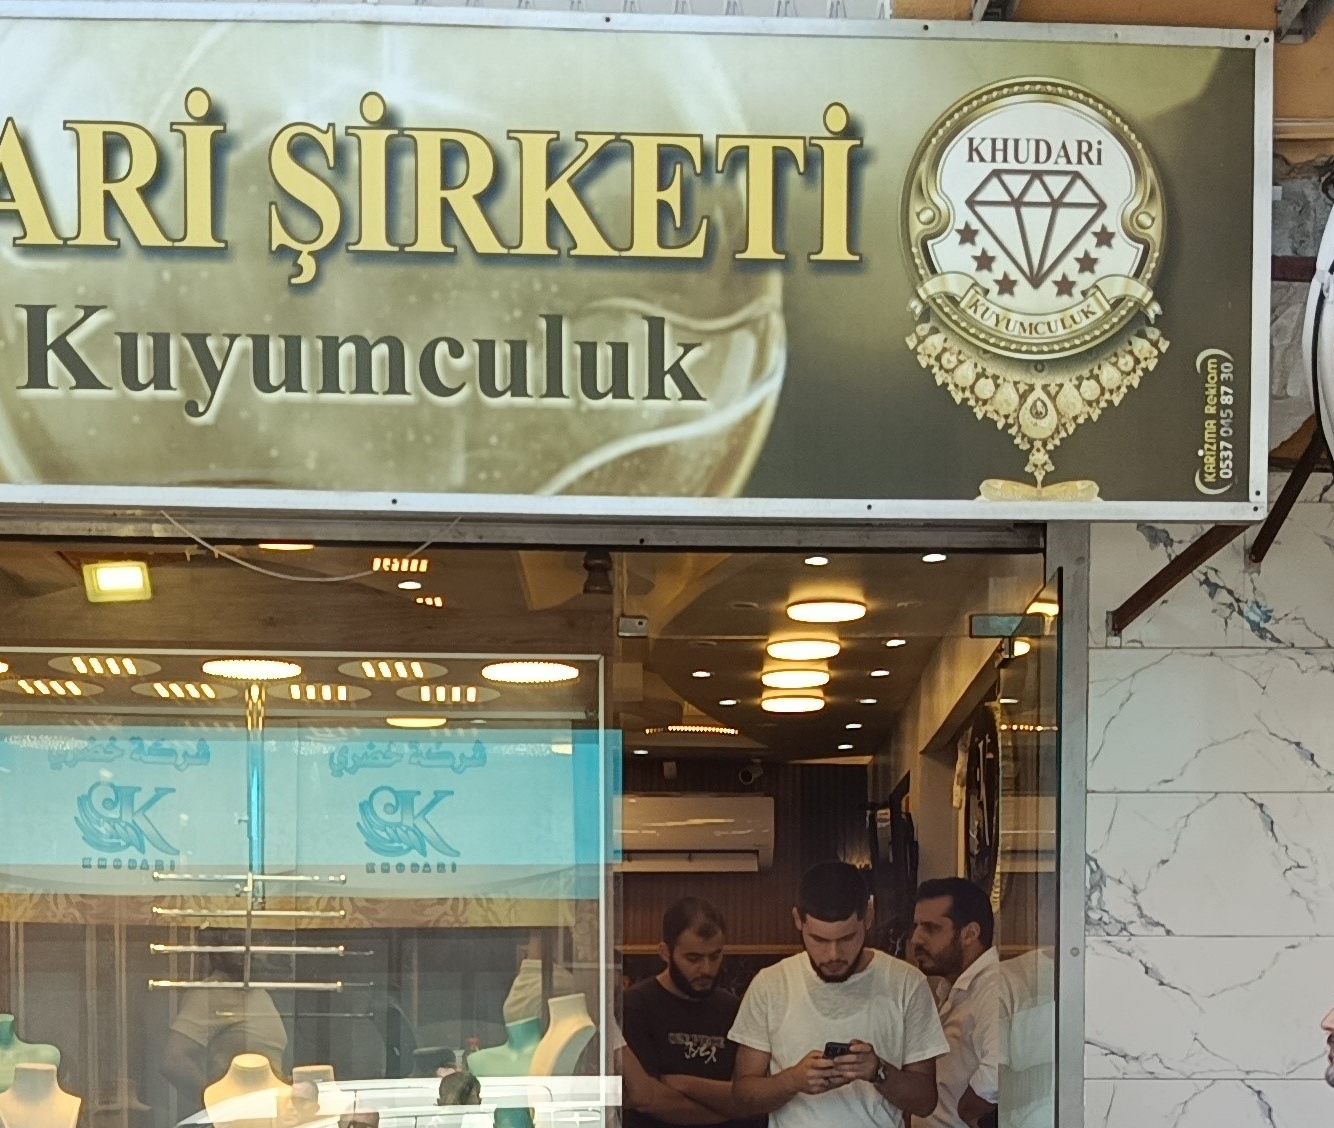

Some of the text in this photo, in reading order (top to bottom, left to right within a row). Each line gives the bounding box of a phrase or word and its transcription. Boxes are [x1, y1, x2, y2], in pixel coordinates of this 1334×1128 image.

[268, 91, 864, 285] ŞİRKETİ
[968, 298, 1097, 336] KUYUMCULUK
[15, 303, 708, 418] Kuyumculuk
[1221, 362, 1234, 381] 30
[1220, 384, 1234, 405] 87
[1220, 440, 1233, 479] 0537
